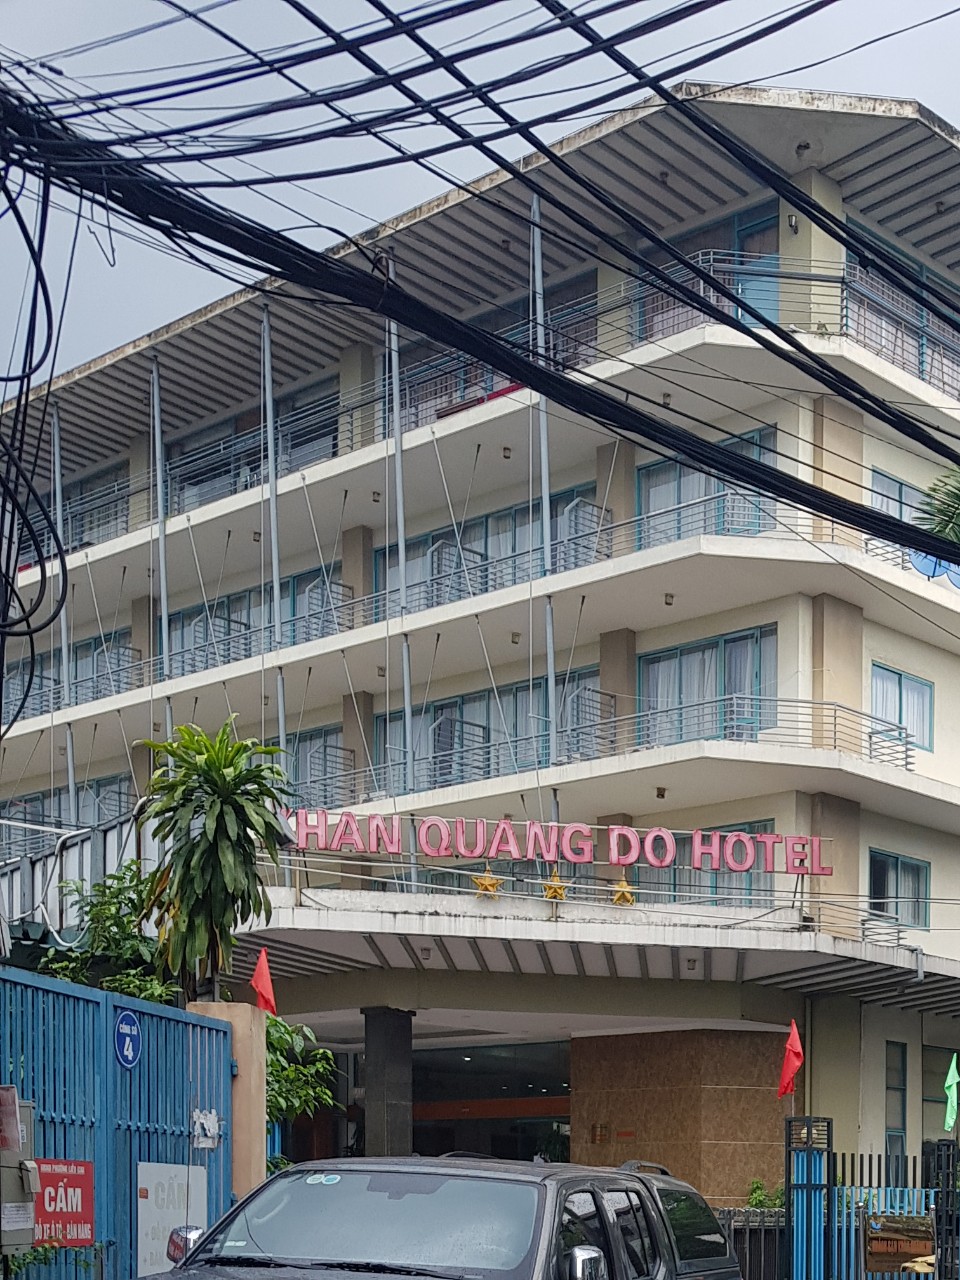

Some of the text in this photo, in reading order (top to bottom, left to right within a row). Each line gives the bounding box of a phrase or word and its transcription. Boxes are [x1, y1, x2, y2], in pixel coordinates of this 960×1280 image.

[418, 815, 594, 864] QUANG
[608, 825, 677, 868] DO
[692, 829, 833, 876] HOTEL
[123, 1036, 134, 1061] 4
[44, 1178, 82, 1213] CẤM
